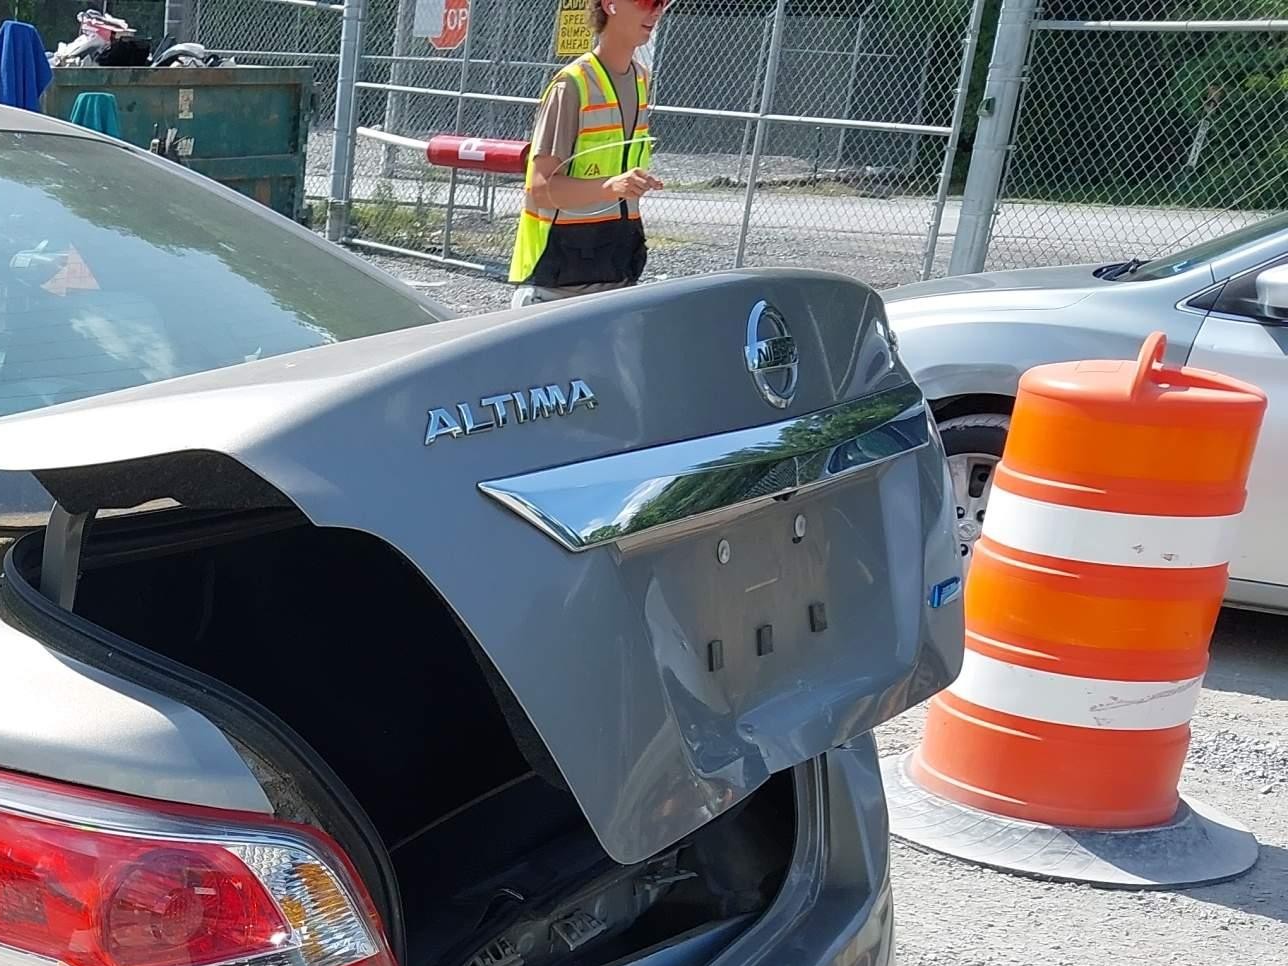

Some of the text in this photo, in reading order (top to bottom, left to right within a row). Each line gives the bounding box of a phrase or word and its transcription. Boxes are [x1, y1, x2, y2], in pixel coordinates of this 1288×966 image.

[443, 8, 468, 30] OP
[560, 39, 589, 49] AHEAD
[424, 379, 598, 446] ALTIMA
